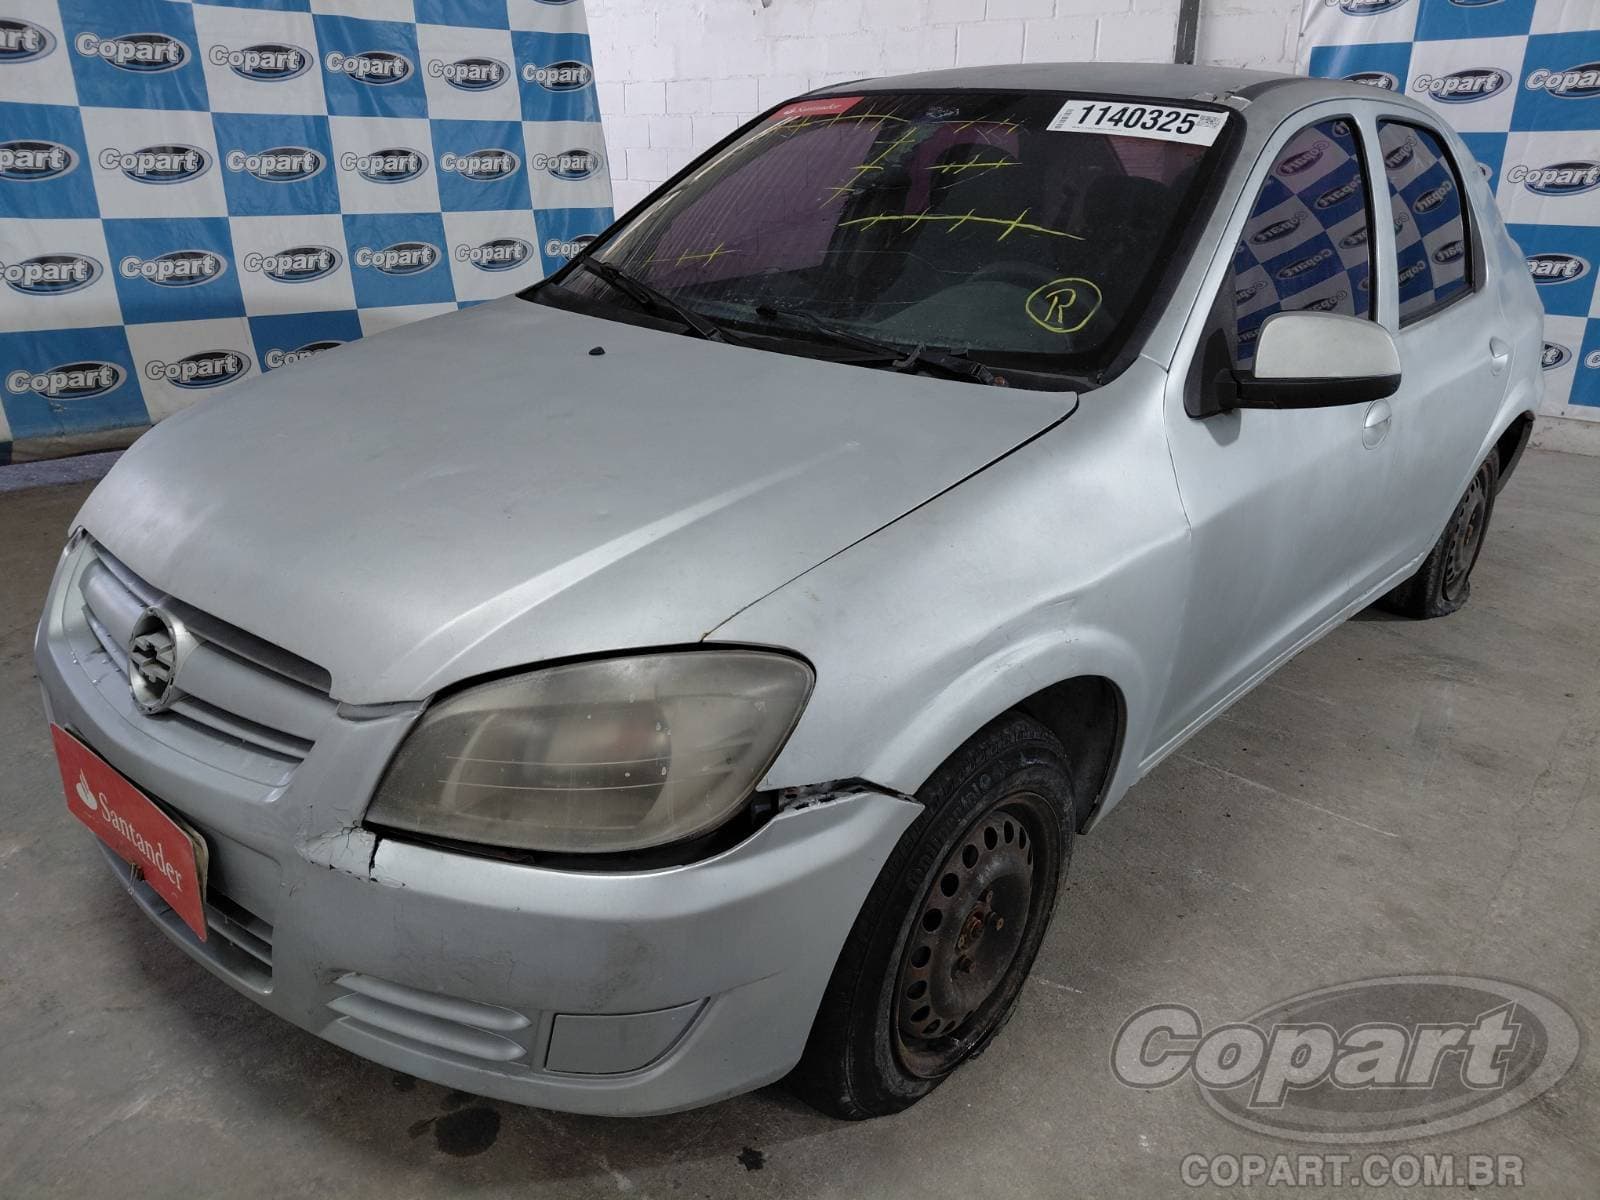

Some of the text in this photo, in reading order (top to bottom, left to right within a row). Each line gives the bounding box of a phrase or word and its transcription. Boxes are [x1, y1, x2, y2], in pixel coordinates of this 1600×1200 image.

[0, 27, 39, 50] art
[75, 32, 180, 64] Copart
[209, 44, 300, 72] Copart
[325, 51, 404, 77] Copart
[428, 58, 500, 84] Copart
[522, 63, 587, 87] Copart
[1412, 71, 1500, 97] Copart
[1078, 104, 1200, 135] 1140325
[0, 147, 65, 172] part
[99, 148, 200, 176] Copart
[227, 150, 315, 177] Copart
[340, 152, 420, 175] Copart
[441, 152, 513, 175] Copart
[532, 153, 594, 173] Copart
[1507, 164, 1600, 189] Copart
[355, 245, 433, 269] Copart
[455, 241, 522, 264] Copart
[545, 239, 591, 258] Copa
[0, 258, 88, 287] opart
[119, 254, 214, 281] Copart
[244, 250, 330, 276] Copart
[1527, 255, 1580, 279] part
[1043, 288, 1077, 326] R
[5, 364, 113, 395] Copart
[145, 353, 237, 382] Copart
[99, 792, 183, 893] Santander
